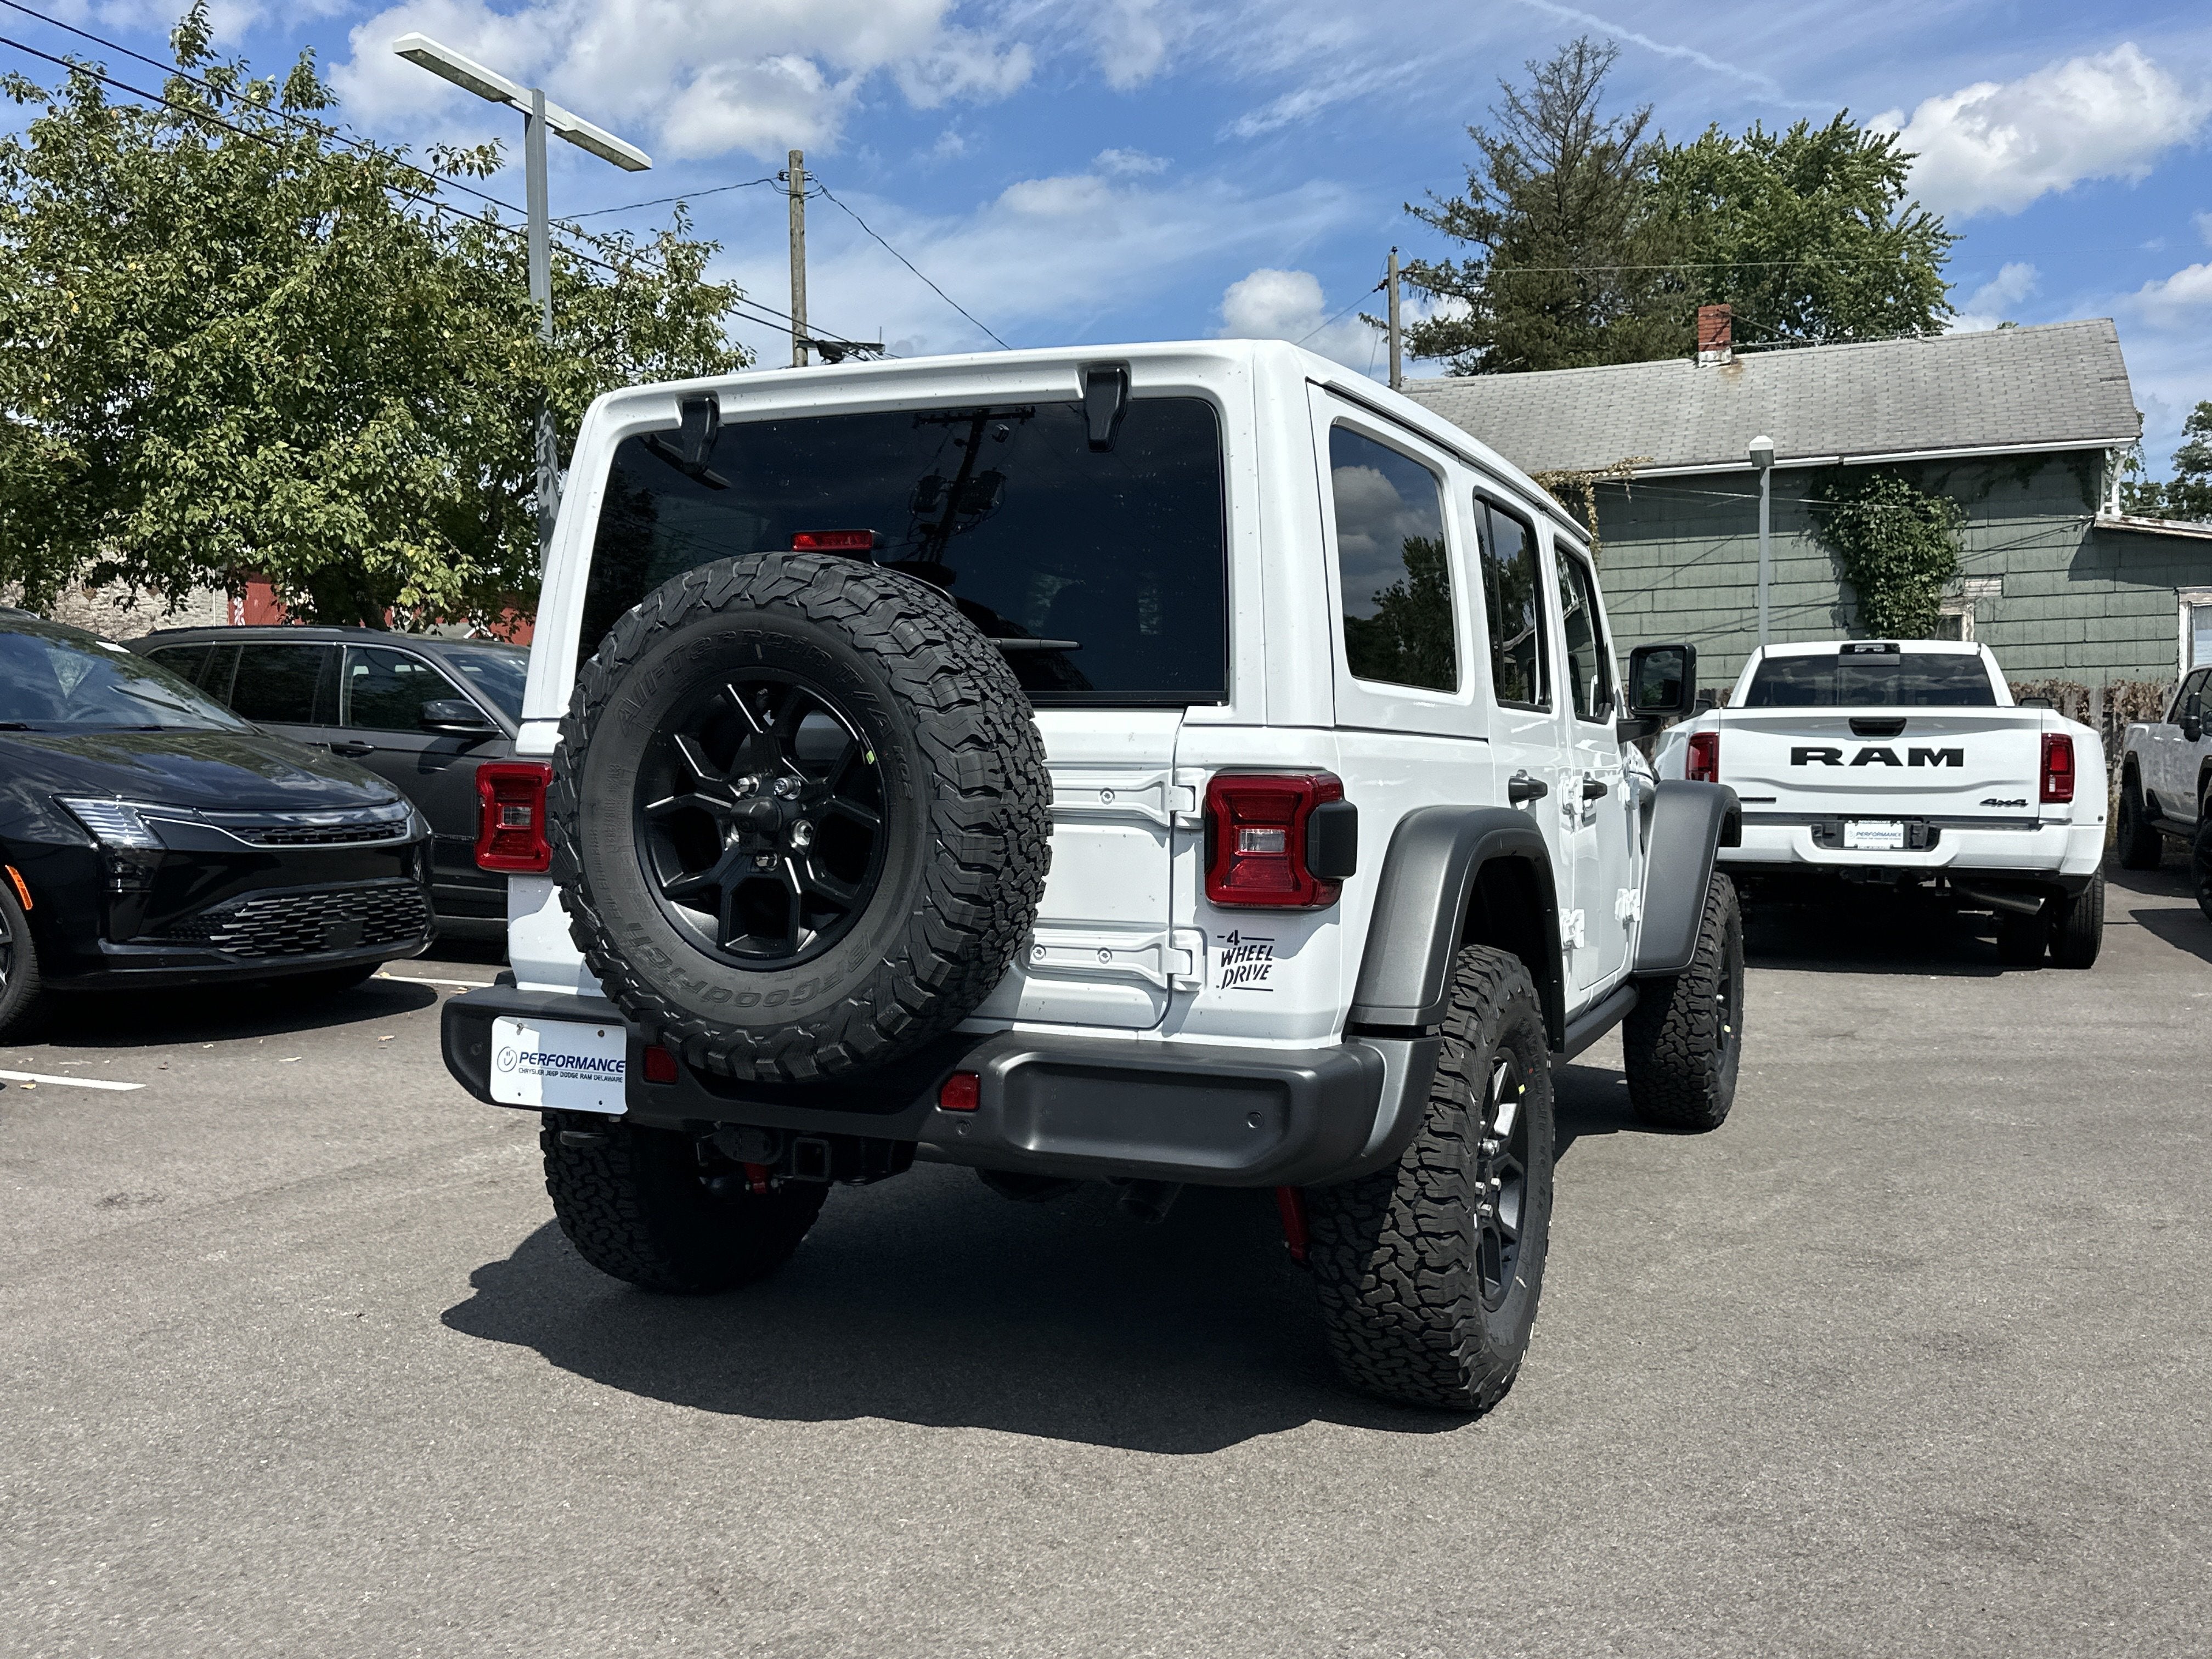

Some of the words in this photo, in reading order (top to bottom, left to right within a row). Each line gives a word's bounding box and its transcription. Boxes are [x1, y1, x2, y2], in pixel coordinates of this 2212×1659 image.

[1791, 747, 1964, 767] RAM
[1979, 798, 2029, 808] 4x4
[1221, 945, 1273, 967] WHEEL
[1221, 964, 1272, 990] DRIVE
[519, 1051, 626, 1073] PERFORMANCE
[594, 1075, 623, 1083] DELAWARE
